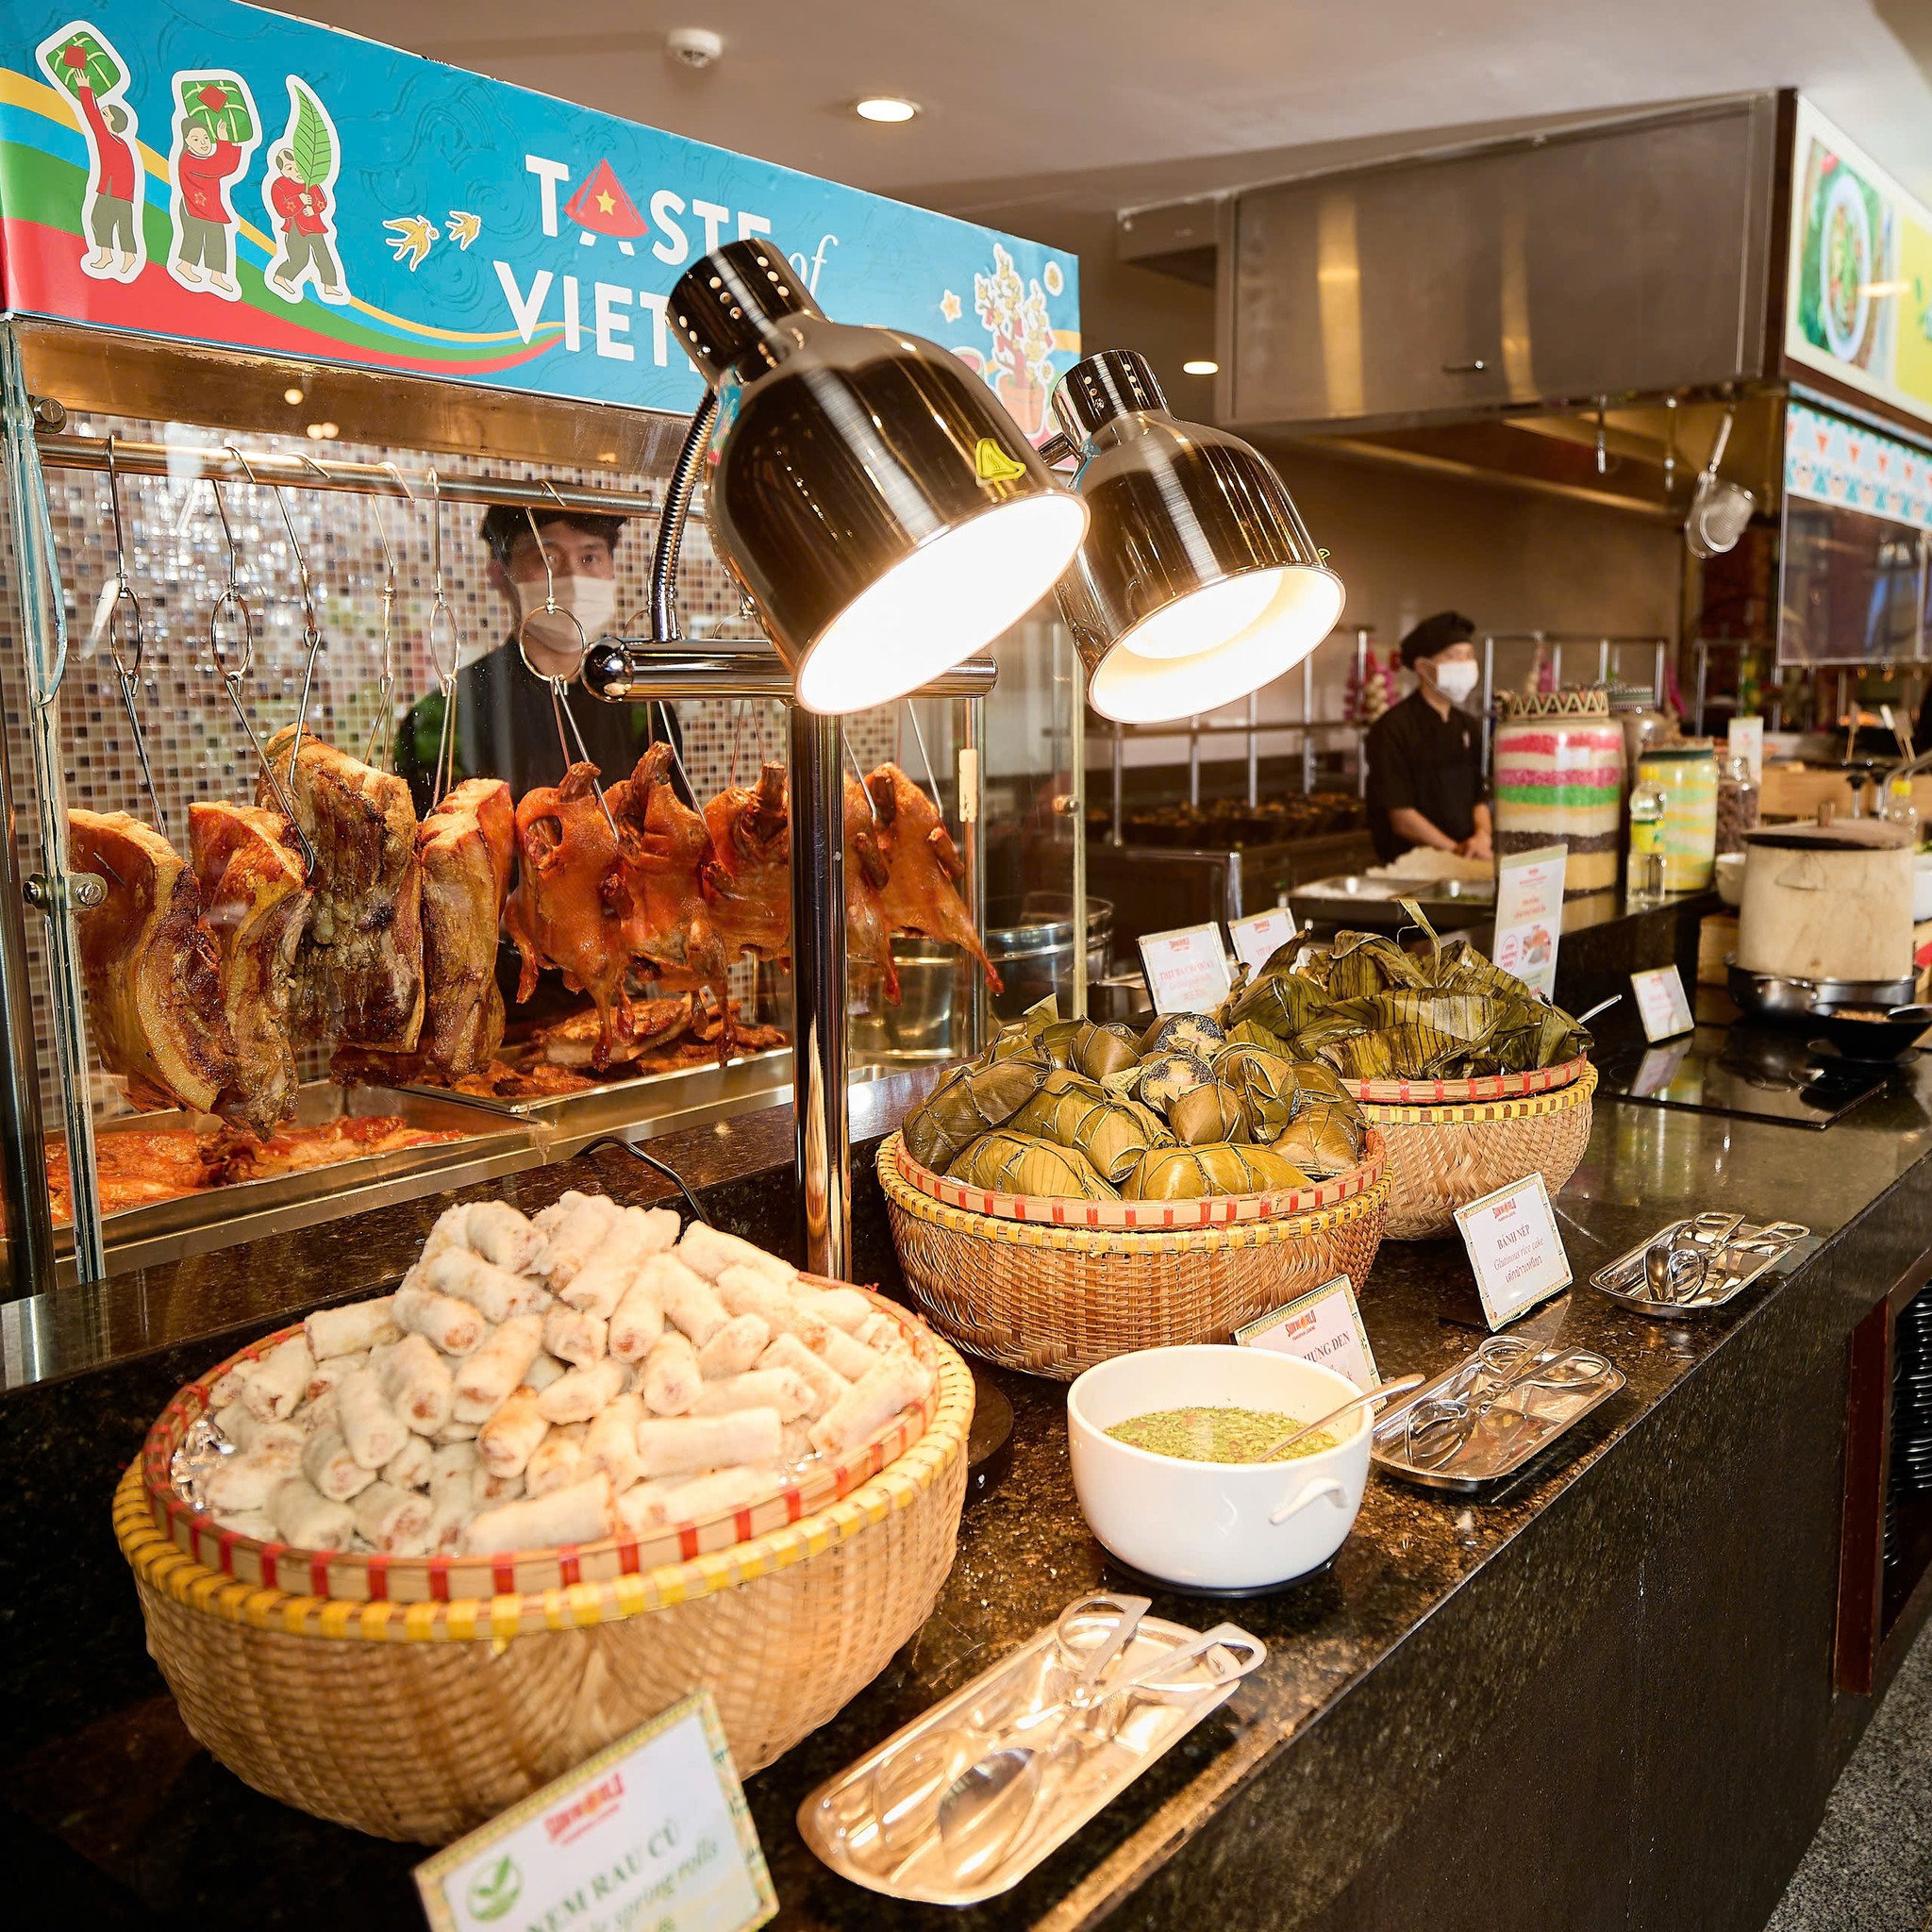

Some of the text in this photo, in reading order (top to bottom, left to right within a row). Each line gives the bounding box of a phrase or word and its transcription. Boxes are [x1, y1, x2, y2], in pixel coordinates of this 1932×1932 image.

[493, 260, 700, 373] VIET
[1521, 1244, 1531, 1256] rice
[1532, 1237, 1544, 1251] cake
[1302, 1341, 1331, 1363] HƯNG
